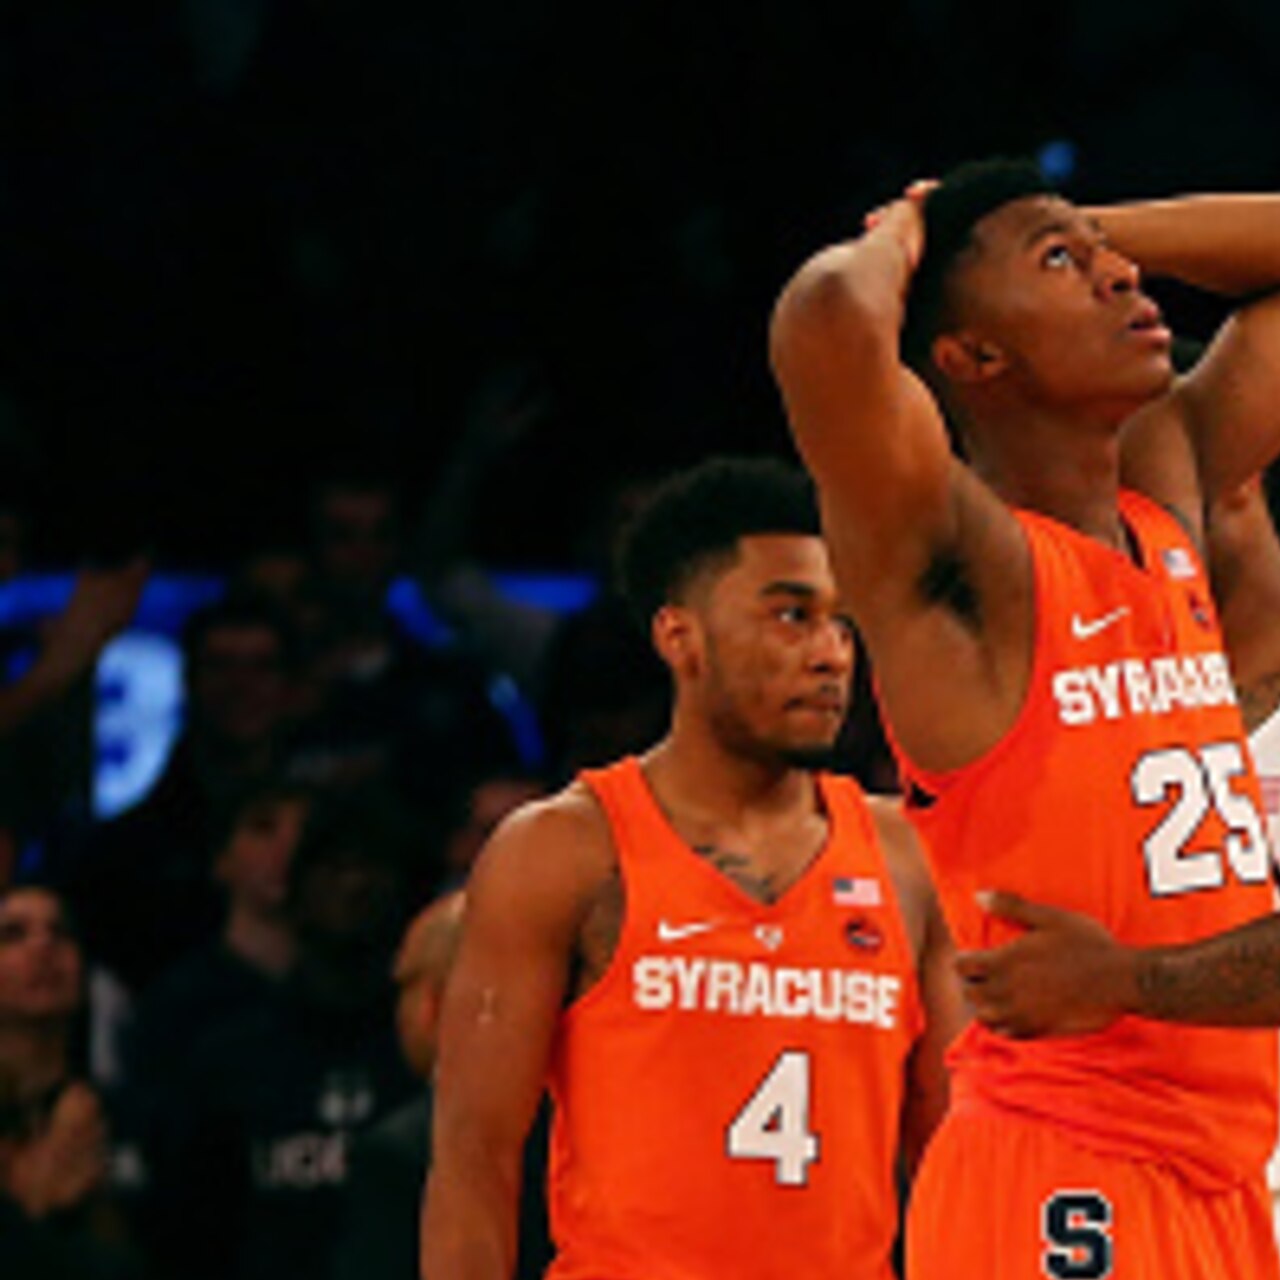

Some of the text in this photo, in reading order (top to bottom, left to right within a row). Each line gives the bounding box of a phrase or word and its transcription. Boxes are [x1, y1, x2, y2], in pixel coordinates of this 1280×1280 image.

[1131, 739, 1267, 895] 25
[632, 955, 900, 1030] SYRACUSE
[725, 1049, 819, 1186] 4
